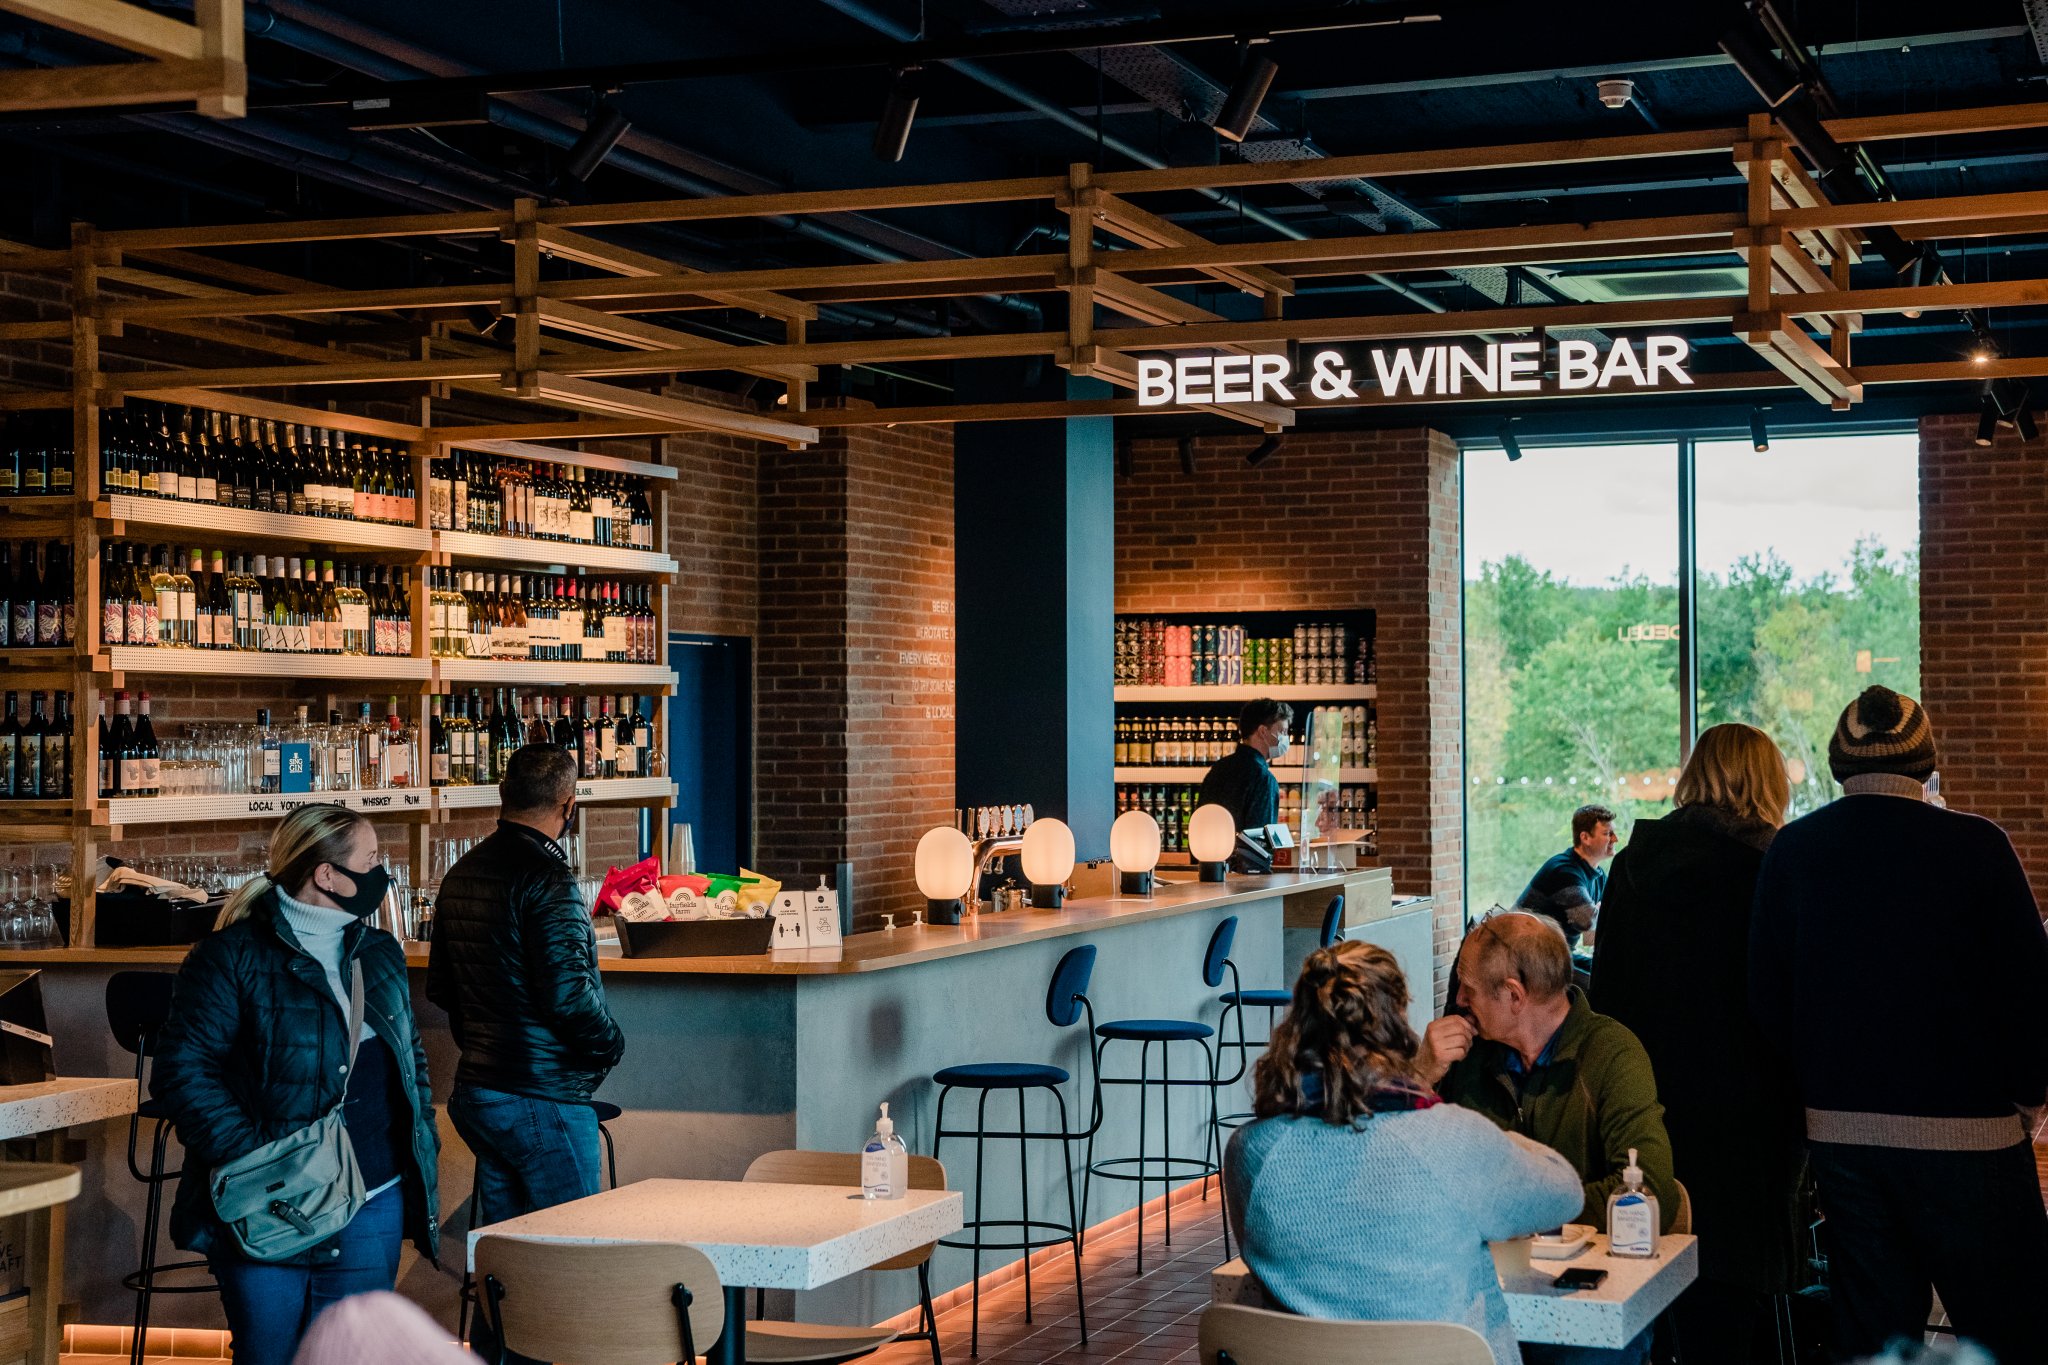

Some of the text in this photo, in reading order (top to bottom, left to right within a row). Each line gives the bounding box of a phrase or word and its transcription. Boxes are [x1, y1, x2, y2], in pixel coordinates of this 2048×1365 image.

[1138, 335, 1694, 406] BEER & WINE BAR
[932, 601, 949, 613] BEER
[248, 801, 273, 812] LOCAL
[362, 796, 392, 807] WHISKEY
[404, 794, 420, 805] RUM
